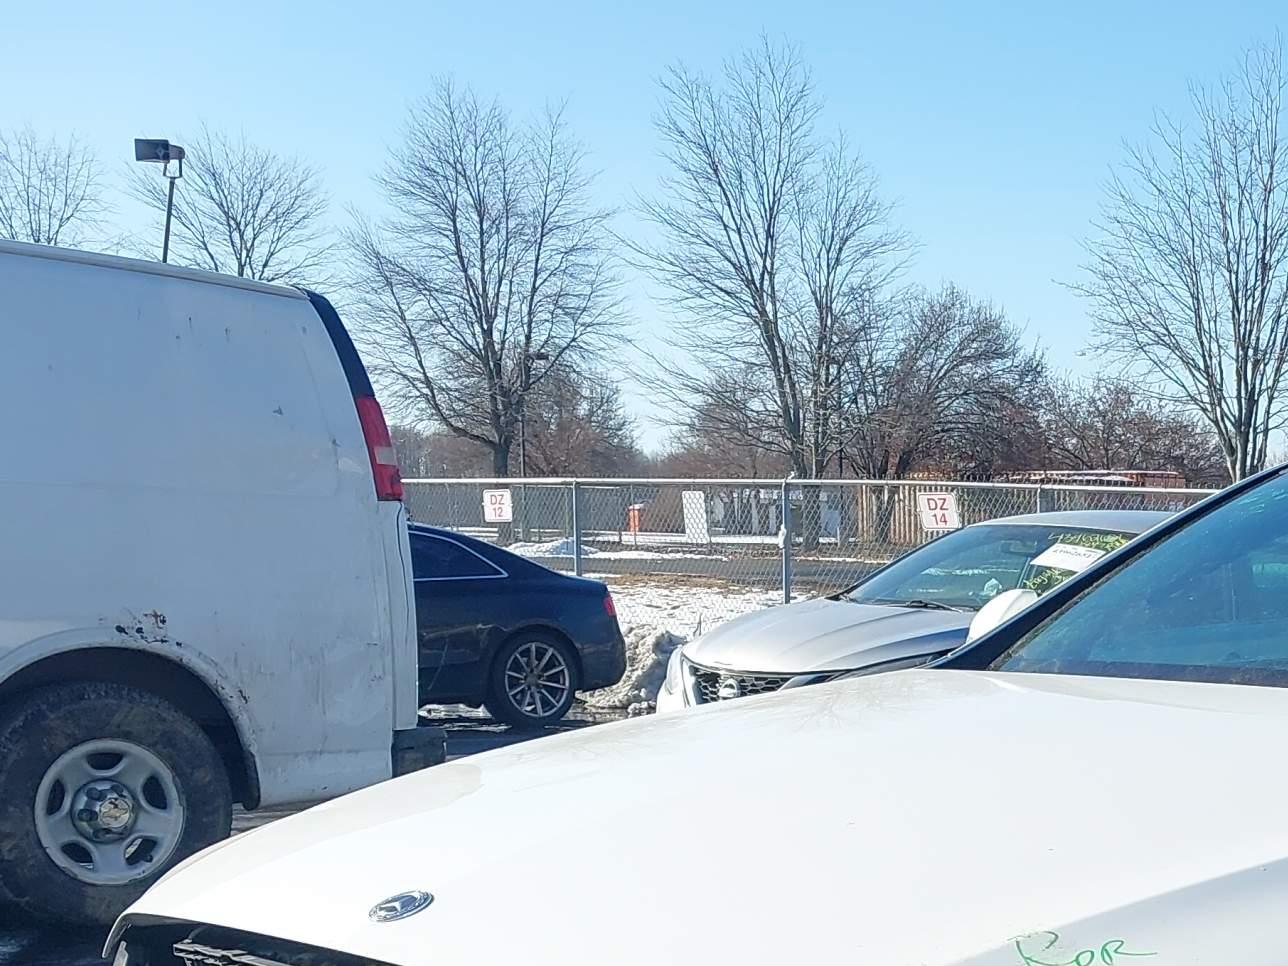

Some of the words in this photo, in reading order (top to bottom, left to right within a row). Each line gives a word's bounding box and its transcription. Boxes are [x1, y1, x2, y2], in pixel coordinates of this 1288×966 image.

[490, 494, 505, 505] DZ
[926, 497, 949, 511] DZ
[492, 506, 503, 518] 12
[931, 512, 948, 526] 14
